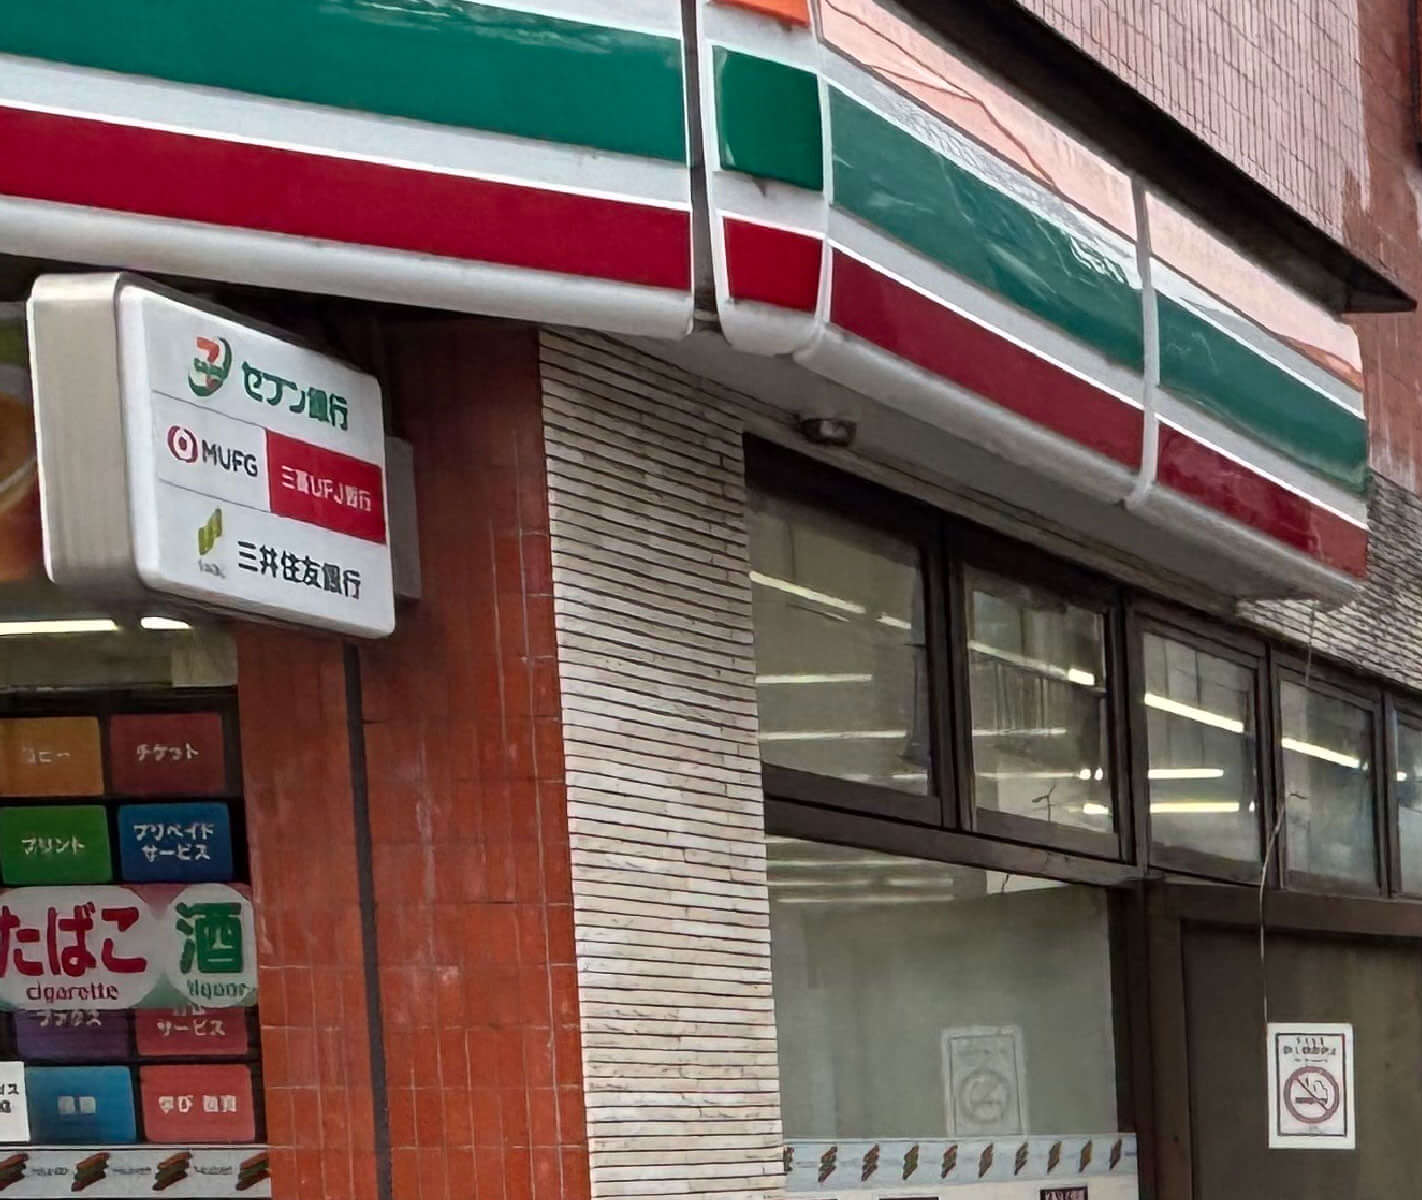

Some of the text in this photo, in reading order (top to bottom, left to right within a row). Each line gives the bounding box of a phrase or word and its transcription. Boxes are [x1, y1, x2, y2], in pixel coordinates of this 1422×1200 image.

[202, 439, 258, 477] MUFG
[238, 541, 361, 599] 三井住友銀行
[136, 743, 199, 761] チケット
[133, 822, 216, 842] プリペイド
[141, 844, 211, 863] サービス
[0, 902, 148, 978] たばこ
[175, 902, 244, 975] 酒
